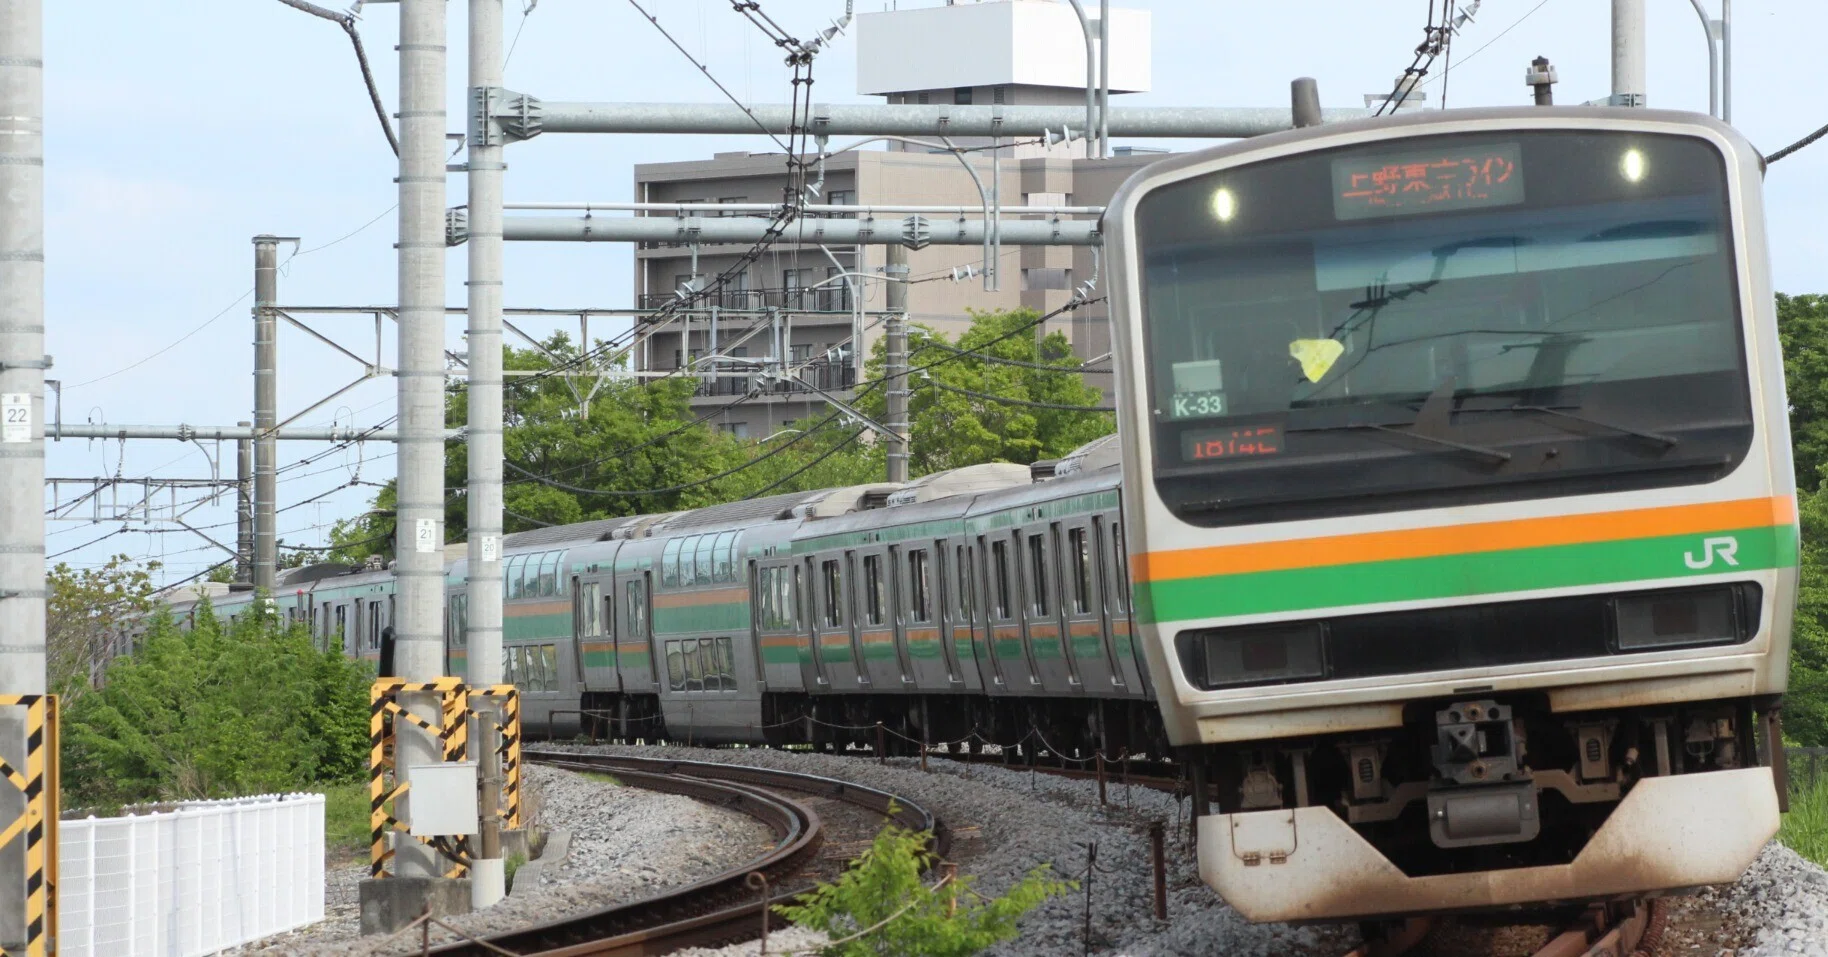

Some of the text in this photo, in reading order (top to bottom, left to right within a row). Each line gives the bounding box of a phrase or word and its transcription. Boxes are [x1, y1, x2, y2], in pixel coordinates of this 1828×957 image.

[1174, 395, 1222, 416] K-33
[8, 408, 27, 422] 22
[420, 528, 432, 539] 21
[484, 543, 495, 552] 20
[1683, 536, 1739, 569] JR
